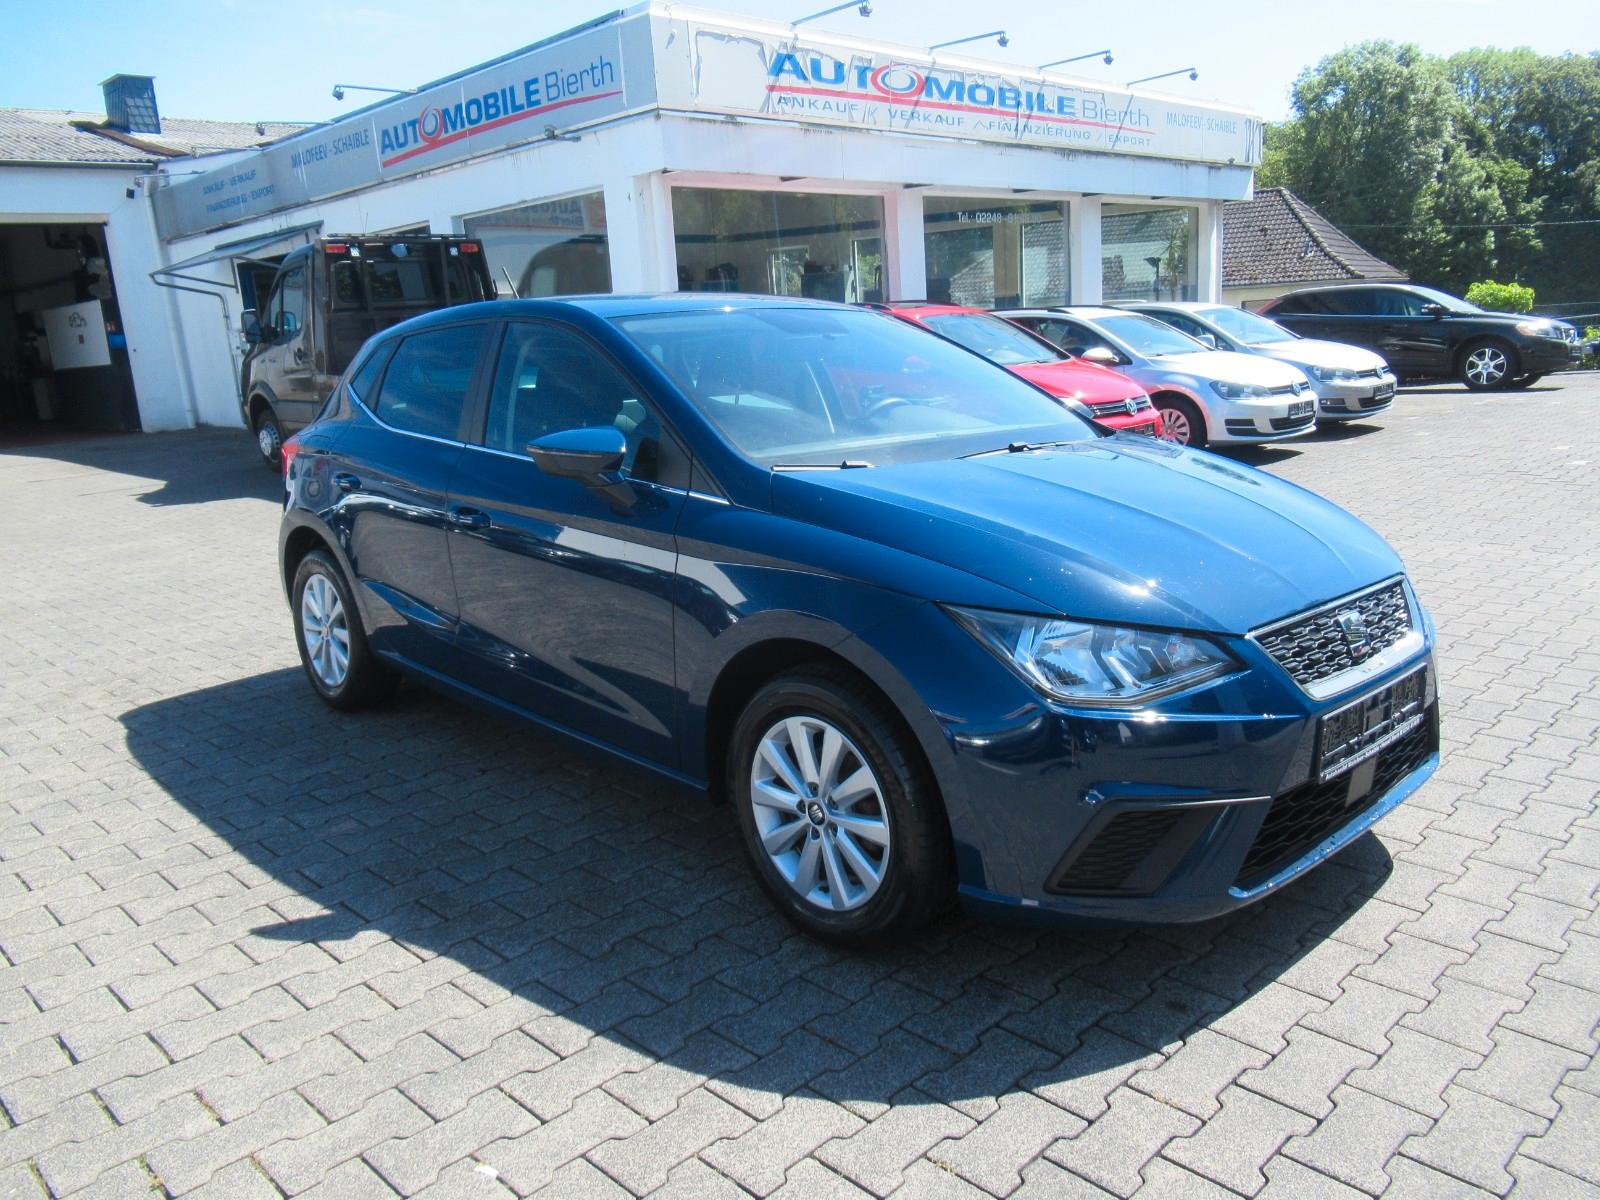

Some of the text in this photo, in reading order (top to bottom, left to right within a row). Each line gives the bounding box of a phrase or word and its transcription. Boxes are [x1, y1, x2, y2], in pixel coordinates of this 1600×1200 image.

[381, 56, 614, 154] AUTOMOBILE Bierth
[767, 53, 1150, 128] AUTOMOBILE Bierth
[333, 128, 370, 155] SCHAIBLE
[777, 95, 859, 114] ANKAUF
[888, 108, 965, 127] VERKAUF
[989, 120, 1091, 140] FINANZIERUNG
[1108, 134, 1151, 147] EXPORT
[1166, 111, 1201, 129] MALOFEEV
[1207, 118, 1237, 134] SCHAIBLE
